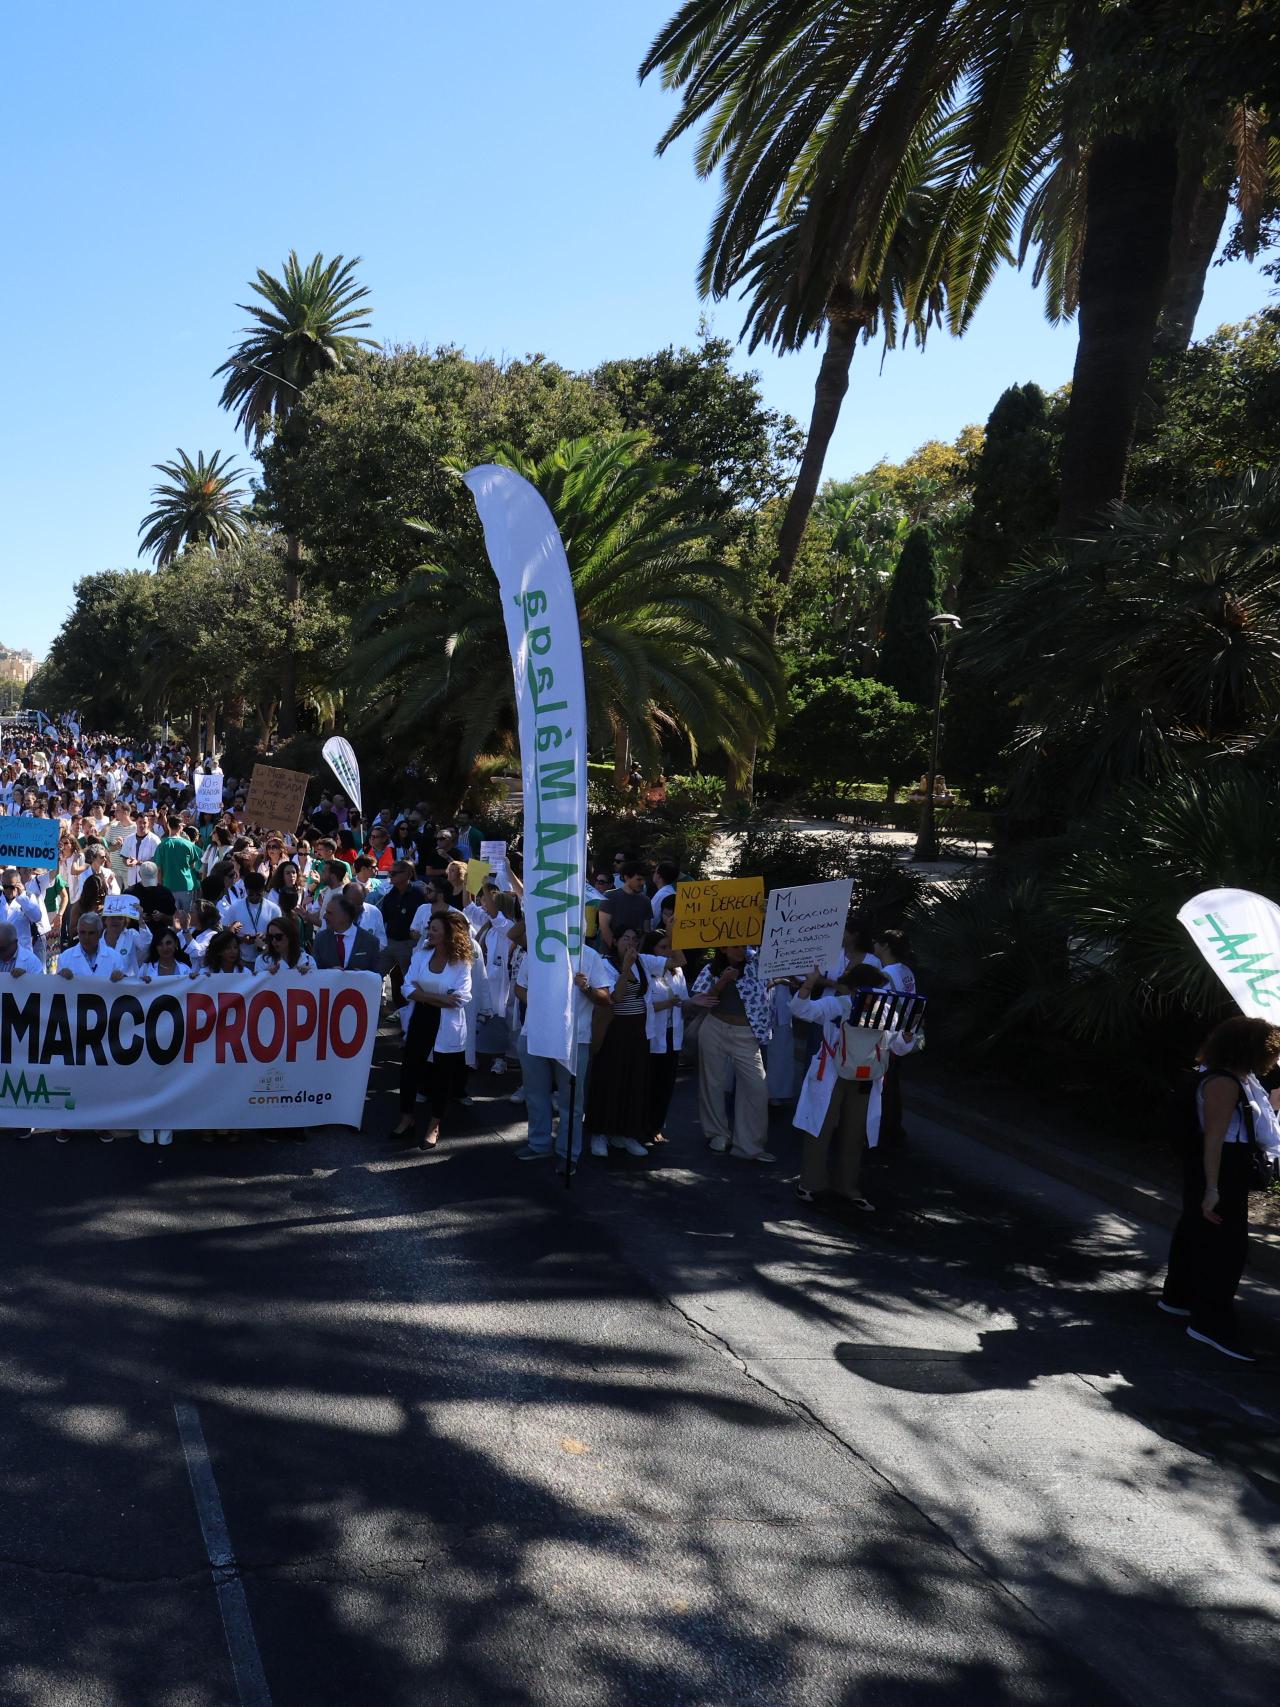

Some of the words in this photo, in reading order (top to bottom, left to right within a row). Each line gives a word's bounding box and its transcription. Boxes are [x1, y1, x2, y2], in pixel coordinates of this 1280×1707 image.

[681, 886, 700, 899] NO
[703, 884, 720, 897] ES
[685, 902, 701, 912] MI
[710, 891, 762, 912] DERECH
[680, 919, 696, 930] ES
[700, 915, 761, 943] SALUD
